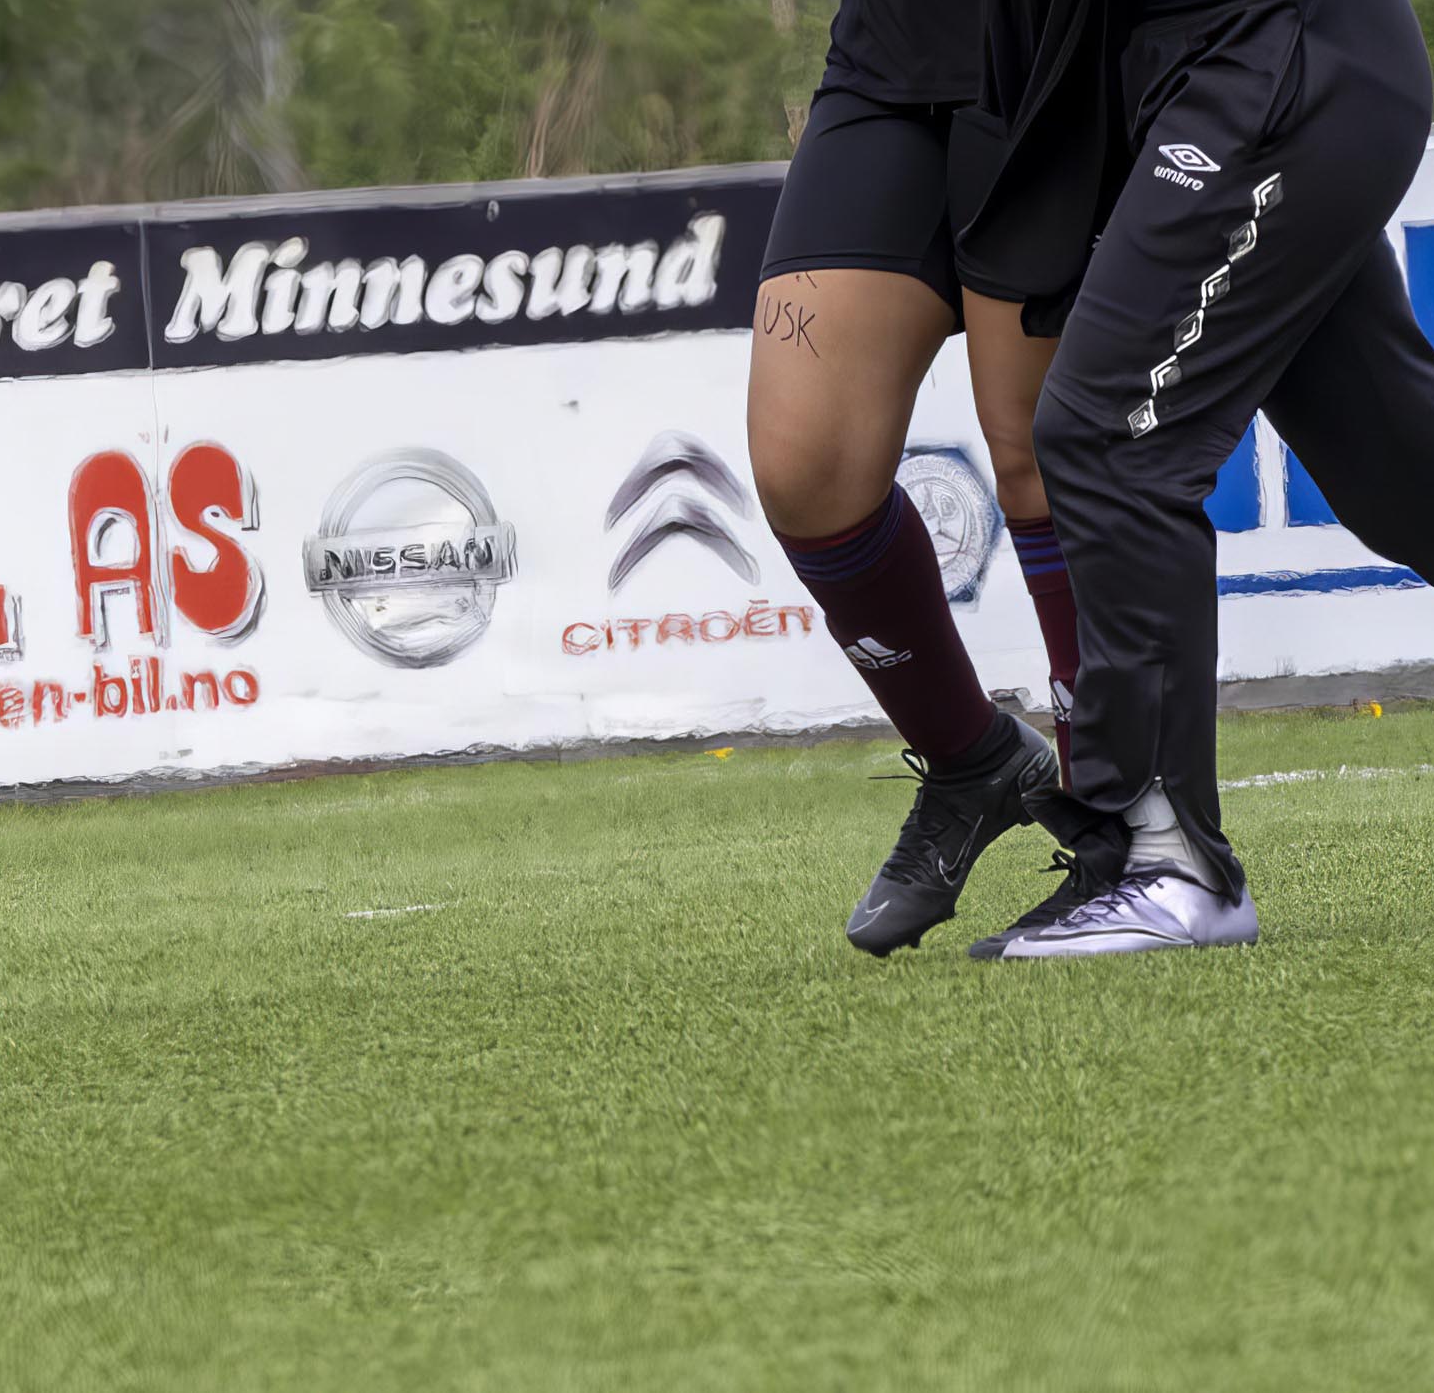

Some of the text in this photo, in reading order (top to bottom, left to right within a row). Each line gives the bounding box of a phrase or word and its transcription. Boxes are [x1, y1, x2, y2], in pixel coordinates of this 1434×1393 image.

[1154, 165, 1204, 191] umbro
[164, 211, 727, 344] Minnesund
[764, 296, 821, 359] USK
[68, 440, 265, 651] AS
[319, 536, 496, 582] NISSAN
